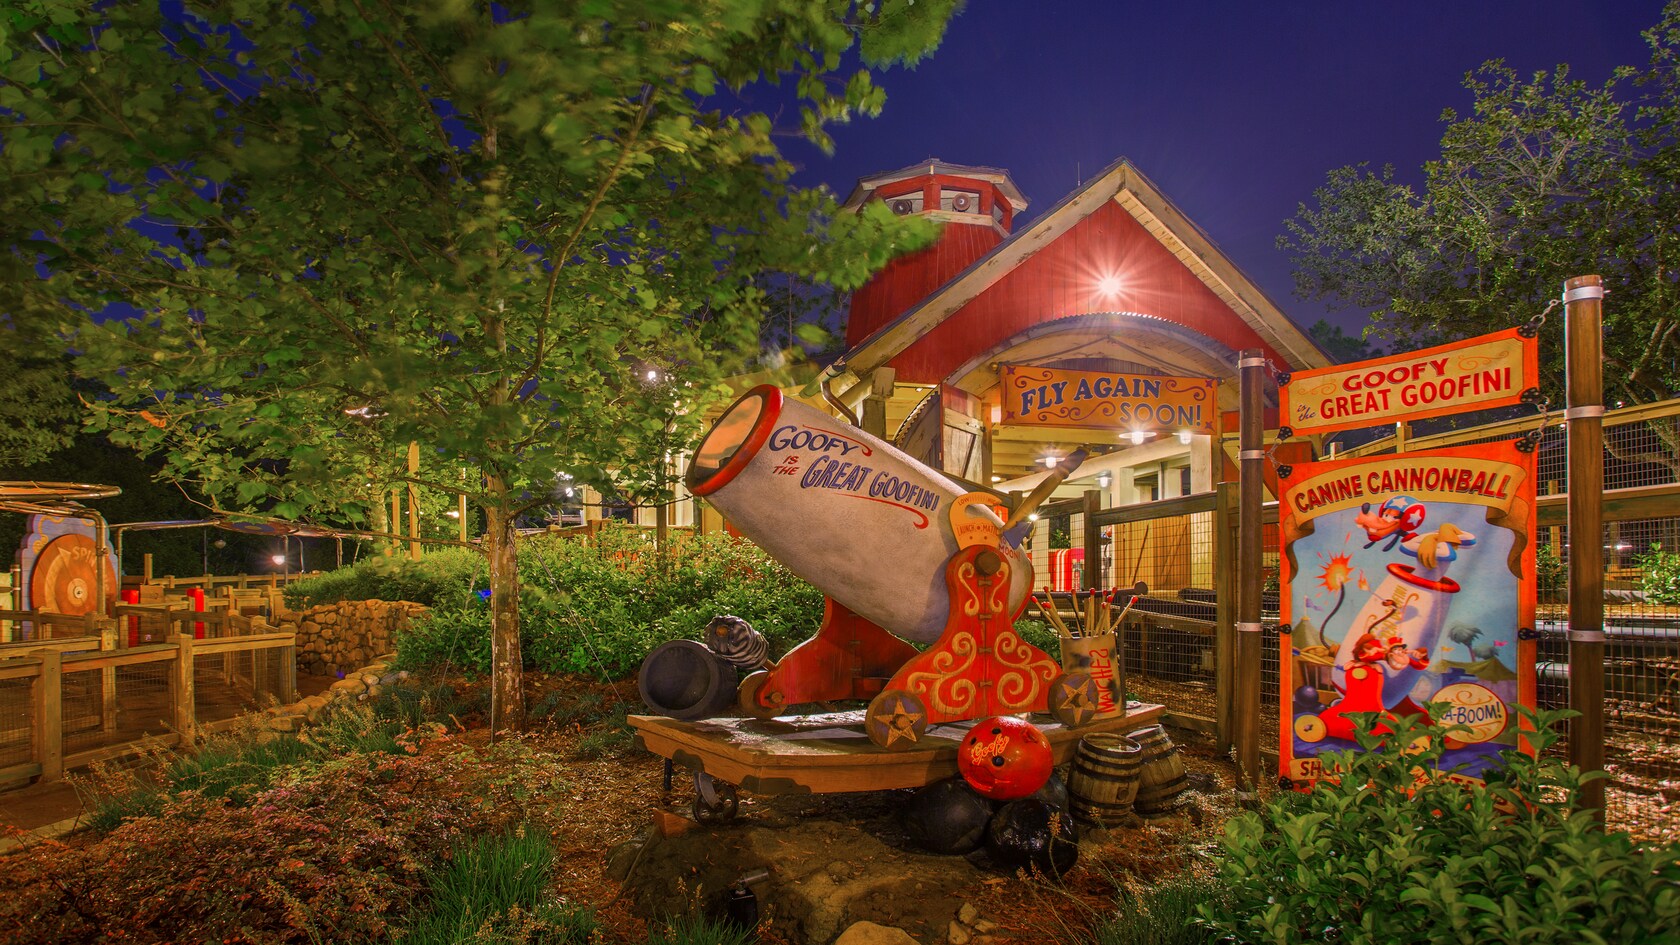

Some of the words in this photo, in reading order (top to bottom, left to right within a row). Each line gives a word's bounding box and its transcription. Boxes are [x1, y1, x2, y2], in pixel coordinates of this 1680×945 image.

[1342, 358, 1449, 392] GOOFY
[1020, 380, 1068, 416] FLY
[1073, 377, 1162, 401] AGAIN
[1320, 388, 1391, 419] GREAT
[1401, 367, 1511, 407] GOOFINI
[1119, 401, 1201, 426] SOON!
[769, 425, 862, 456] GOOFY
[783, 455, 799, 465] IS
[773, 465, 800, 477] THE
[801, 455, 872, 492] GREAT
[869, 471, 941, 511] GOOFINI
[1295, 471, 1364, 514] CANINE
[1367, 467, 1512, 499] CANNONBALL
[1440, 701, 1502, 725] A-BOOM!
